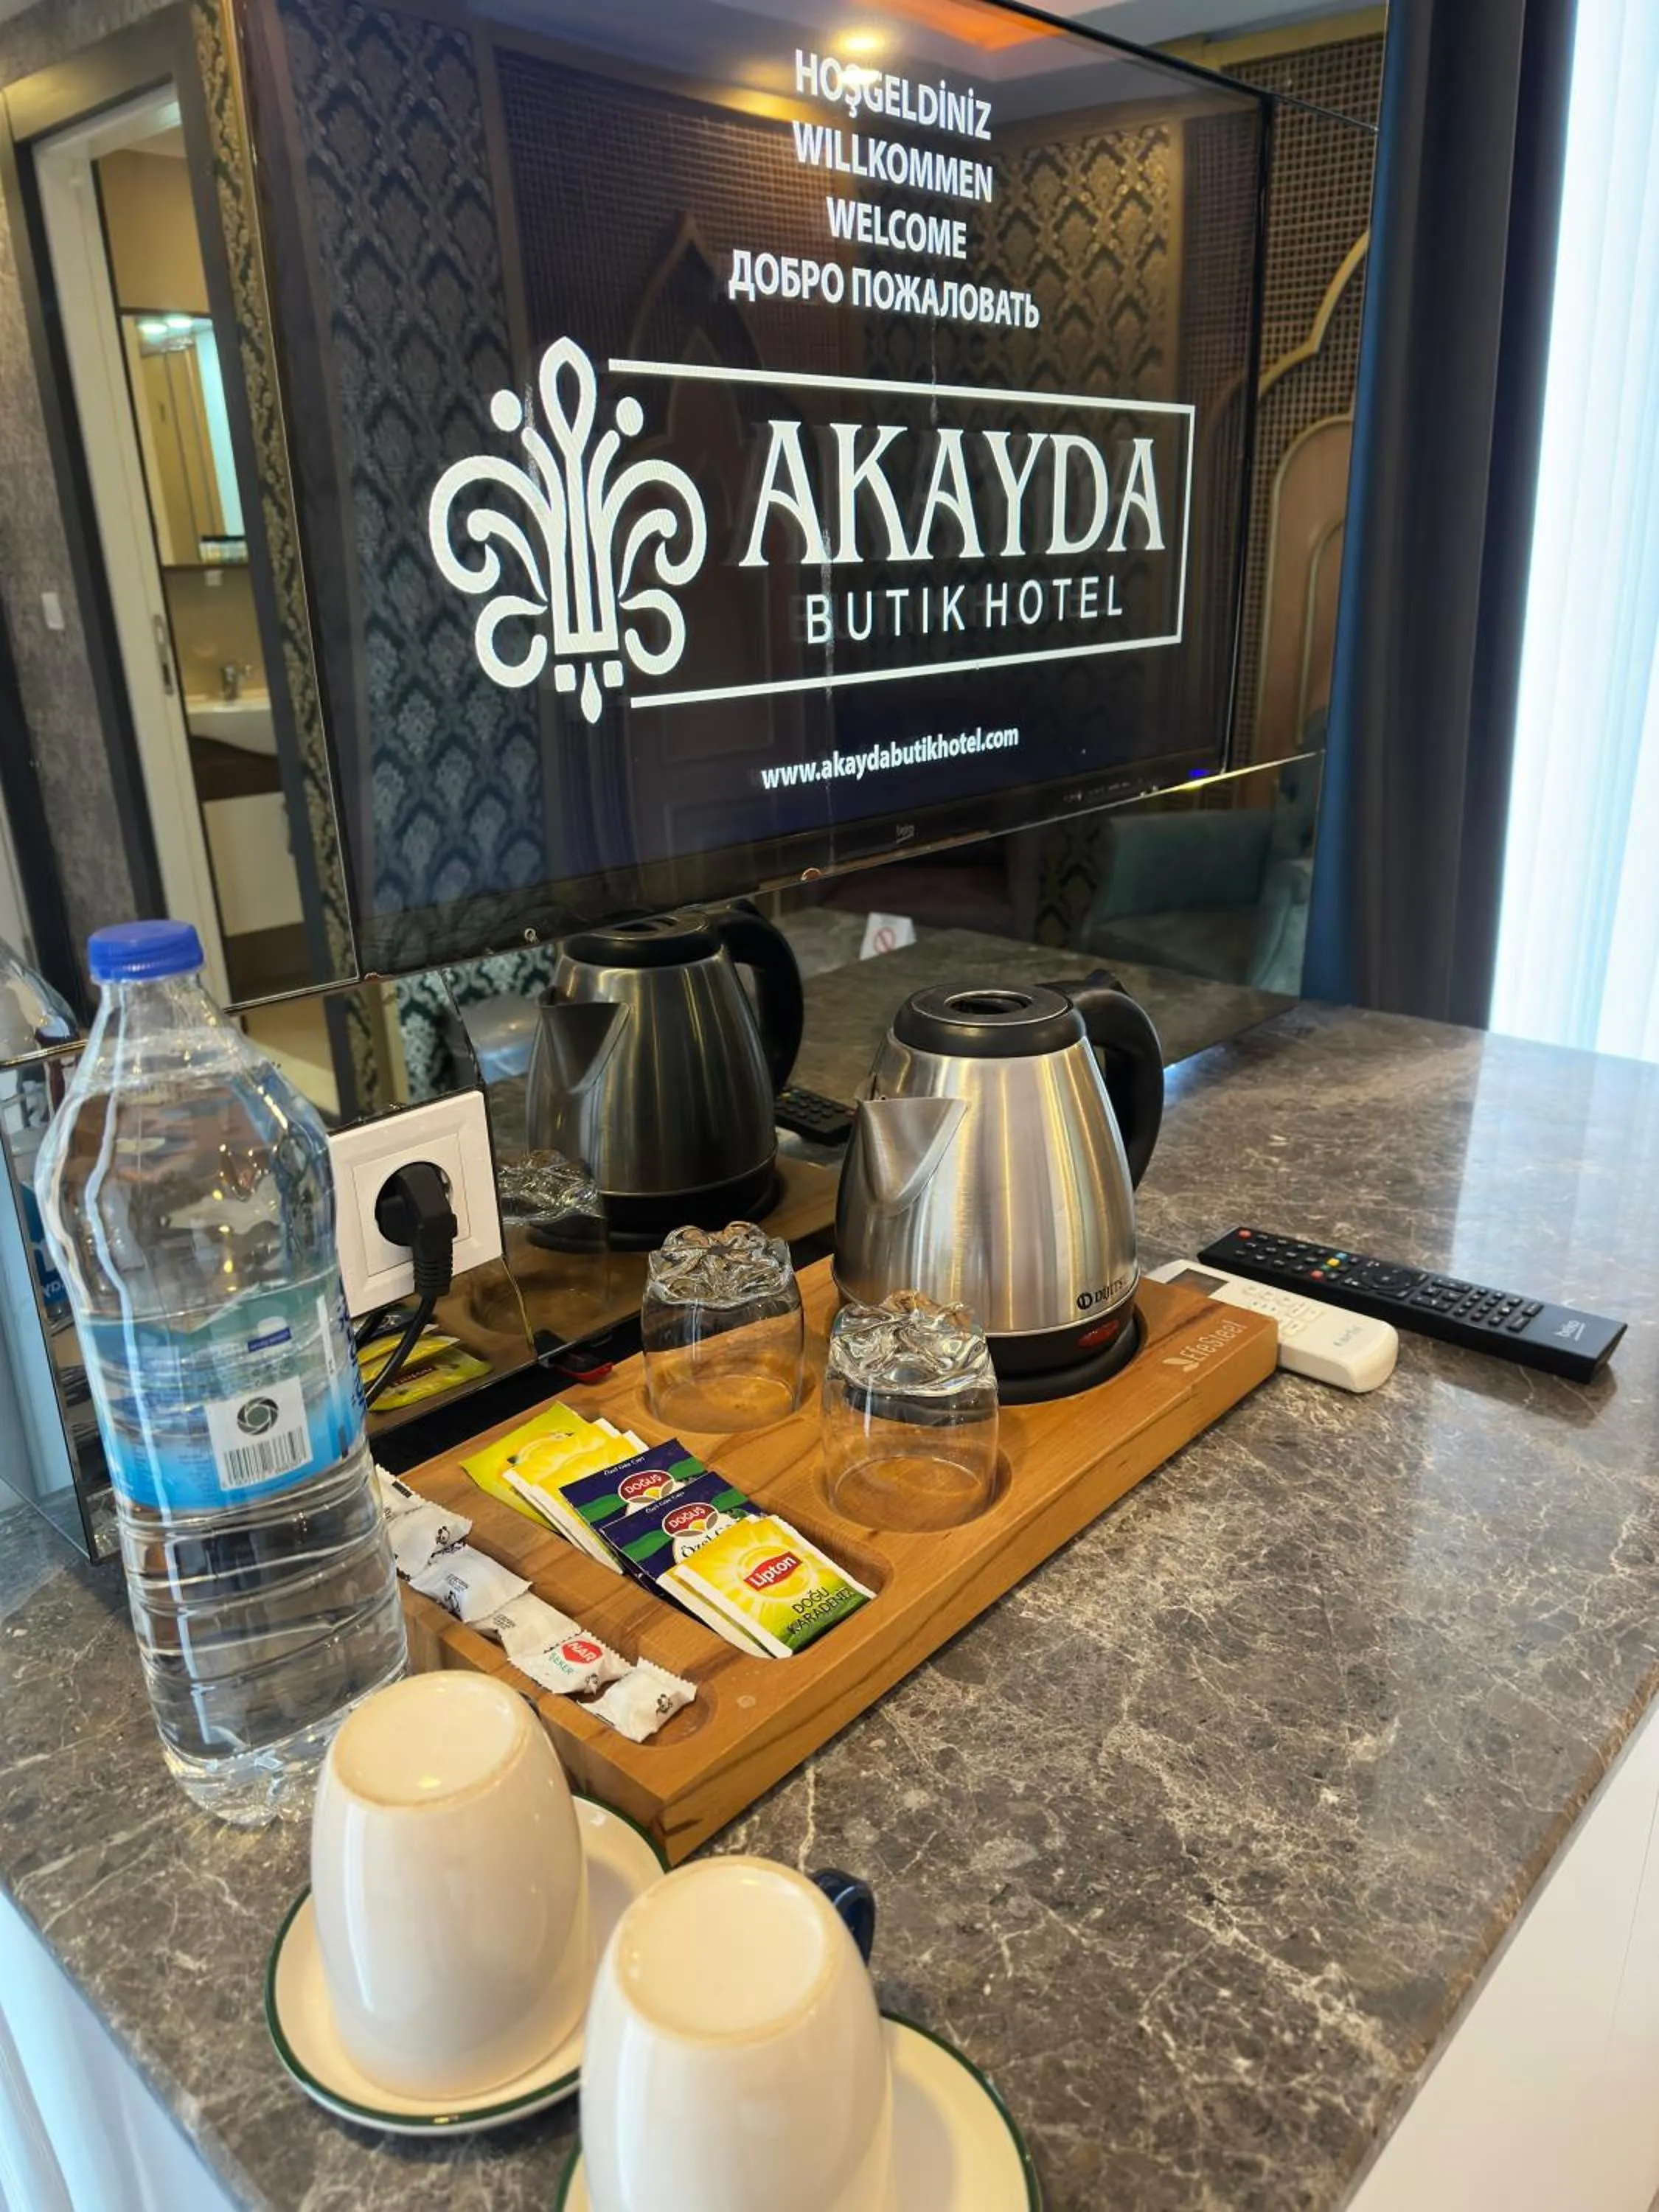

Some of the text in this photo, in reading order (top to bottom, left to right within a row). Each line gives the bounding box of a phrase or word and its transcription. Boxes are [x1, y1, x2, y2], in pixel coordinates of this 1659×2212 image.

[794, 49, 992, 140] HOŞGELDİNİZ
[793, 120, 992, 202] WILLKOMMEN
[826, 197, 967, 260] WELCOME
[728, 249, 1040, 329] ДОБРО ПОЖАЛОВАТЬ
[738, 420, 1165, 566] AKAYDA
[807, 575, 1122, 644] BUTIK HOTEL
[762, 724, 1019, 790] www.akaydabutikhotel.com
[625, 1473, 662, 1495] DOĞUŞ
[668, 1506, 706, 1528] DOĞUŞ
[749, 1557, 796, 1587] Lipton
[791, 1587, 830, 1614] DOĞU
